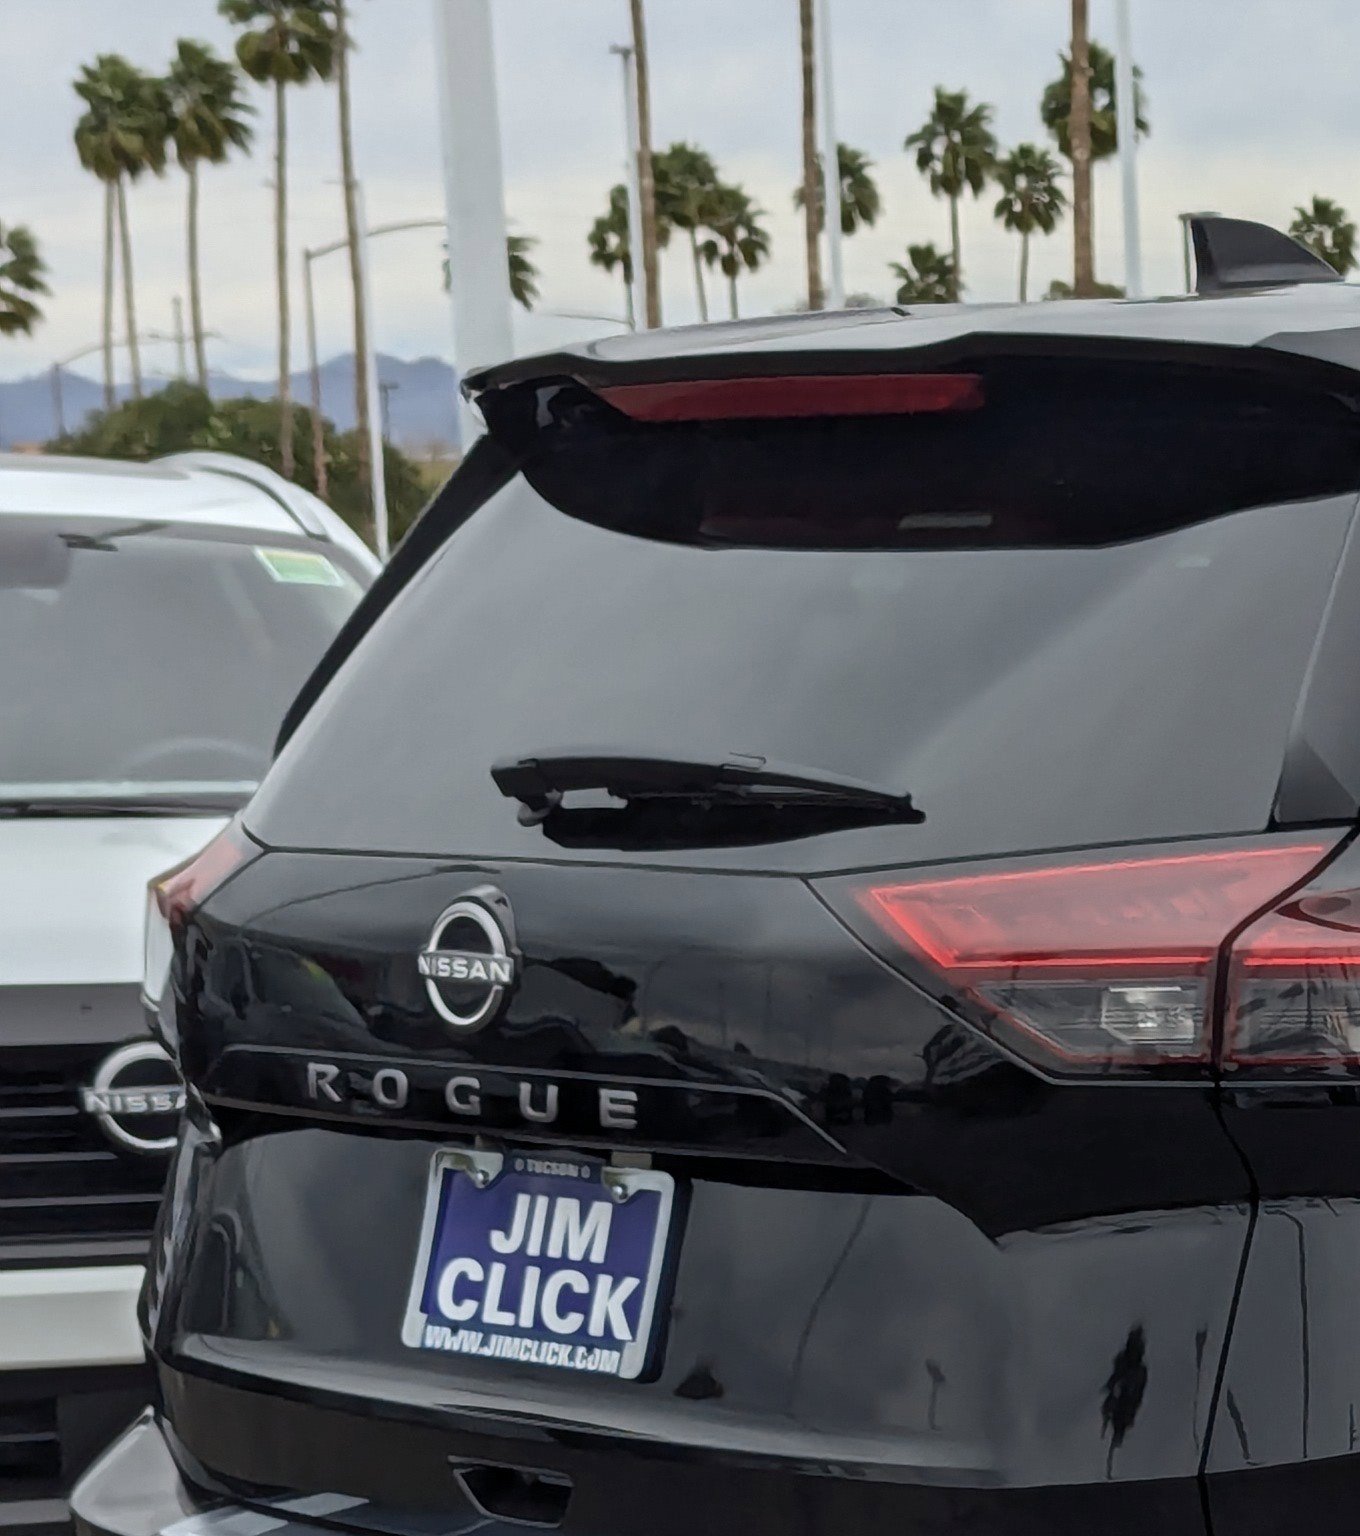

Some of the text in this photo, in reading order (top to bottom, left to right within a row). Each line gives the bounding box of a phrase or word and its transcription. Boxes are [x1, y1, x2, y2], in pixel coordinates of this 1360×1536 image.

[418, 955, 511, 982] NISSAN
[83, 1089, 187, 1113] NISS
[307, 1061, 639, 1130] ROGUE
[489, 1192, 613, 1264] JIM
[437, 1256, 641, 1341] CLICK
[424, 1324, 621, 1374] WWW.JIMCLICK.COM
